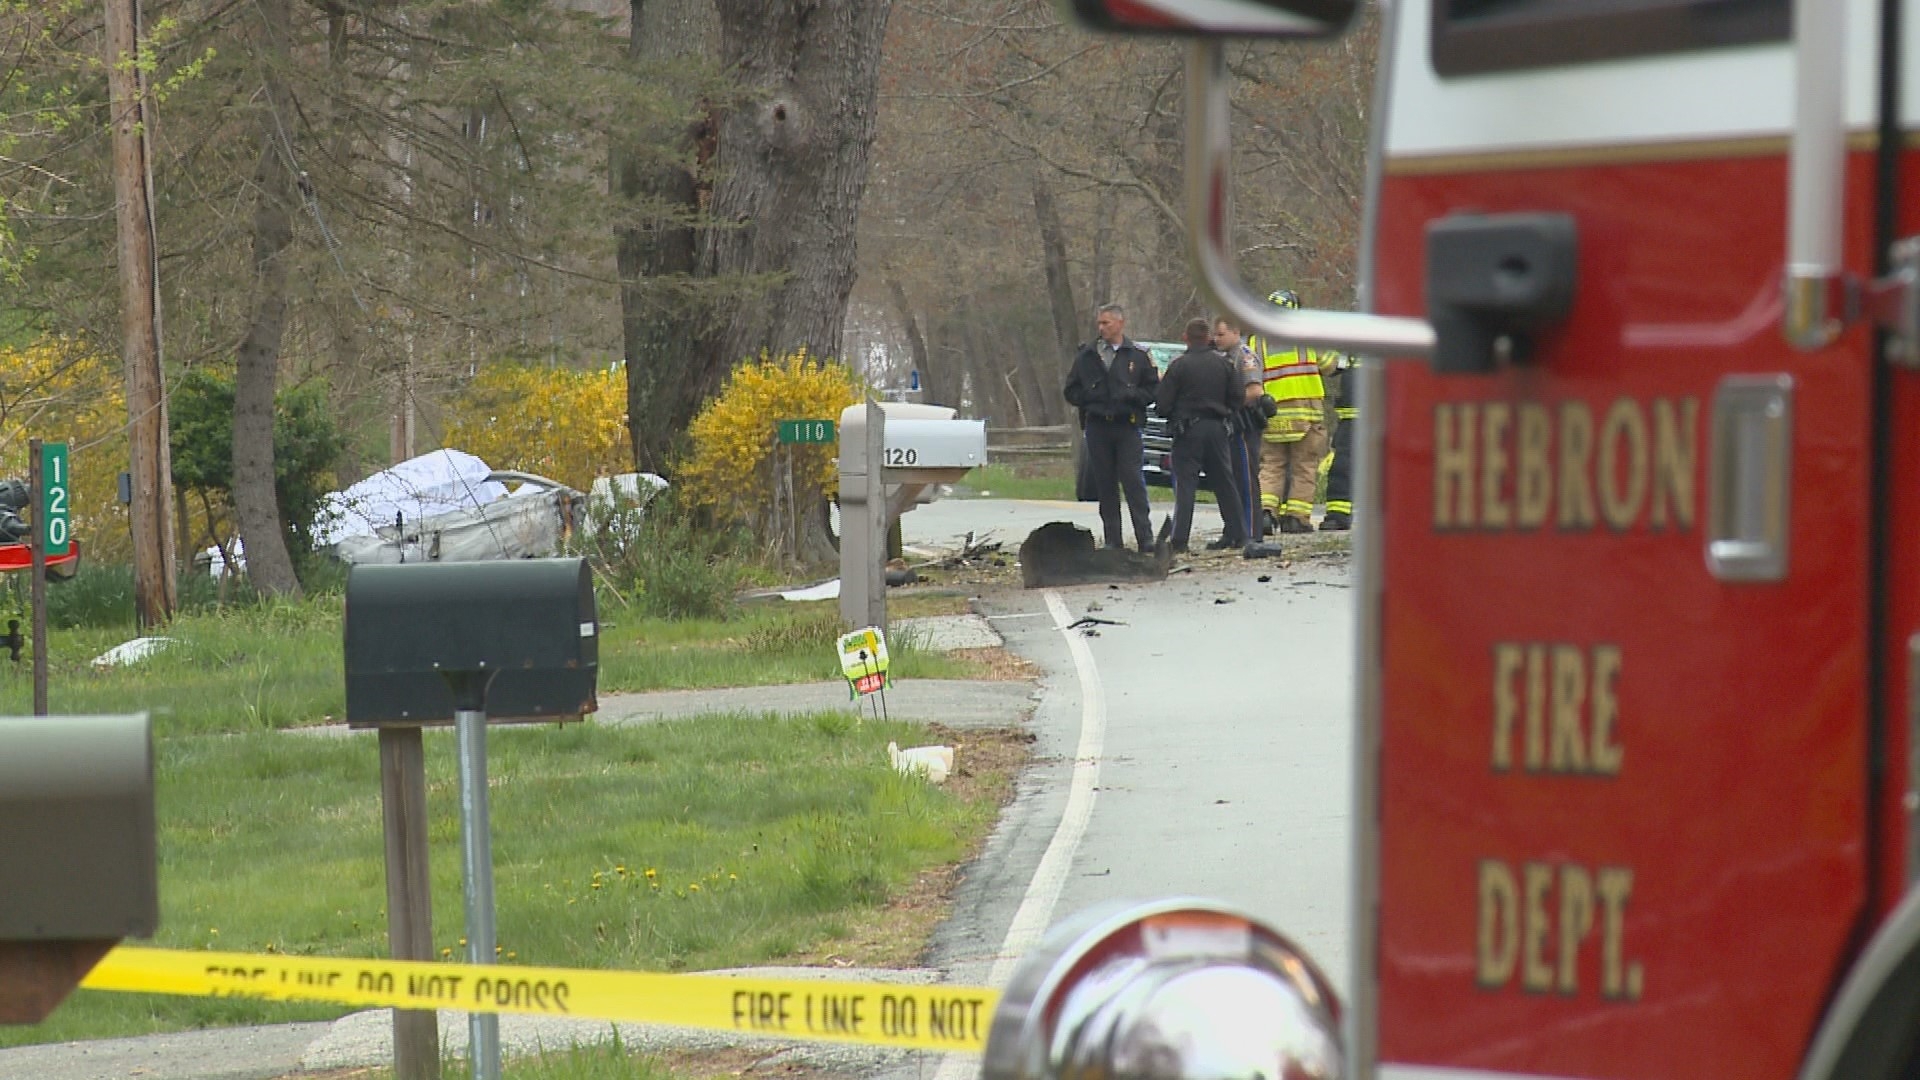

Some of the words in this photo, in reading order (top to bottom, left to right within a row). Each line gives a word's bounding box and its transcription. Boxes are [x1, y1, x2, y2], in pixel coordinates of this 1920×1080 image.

[795, 422, 825, 441] 110
[885, 448, 918, 466] 120
[1432, 396, 1699, 533] HEBRON
[49, 455, 67, 546] 120
[1490, 643, 1625, 777] FIRE
[1475, 857, 1645, 1002] DEPT.
[732, 990, 793, 1030] FIRE
[805, 994, 868, 1036] LINE
[881, 994, 919, 1038] DO
[929, 997, 984, 1041] NOT
